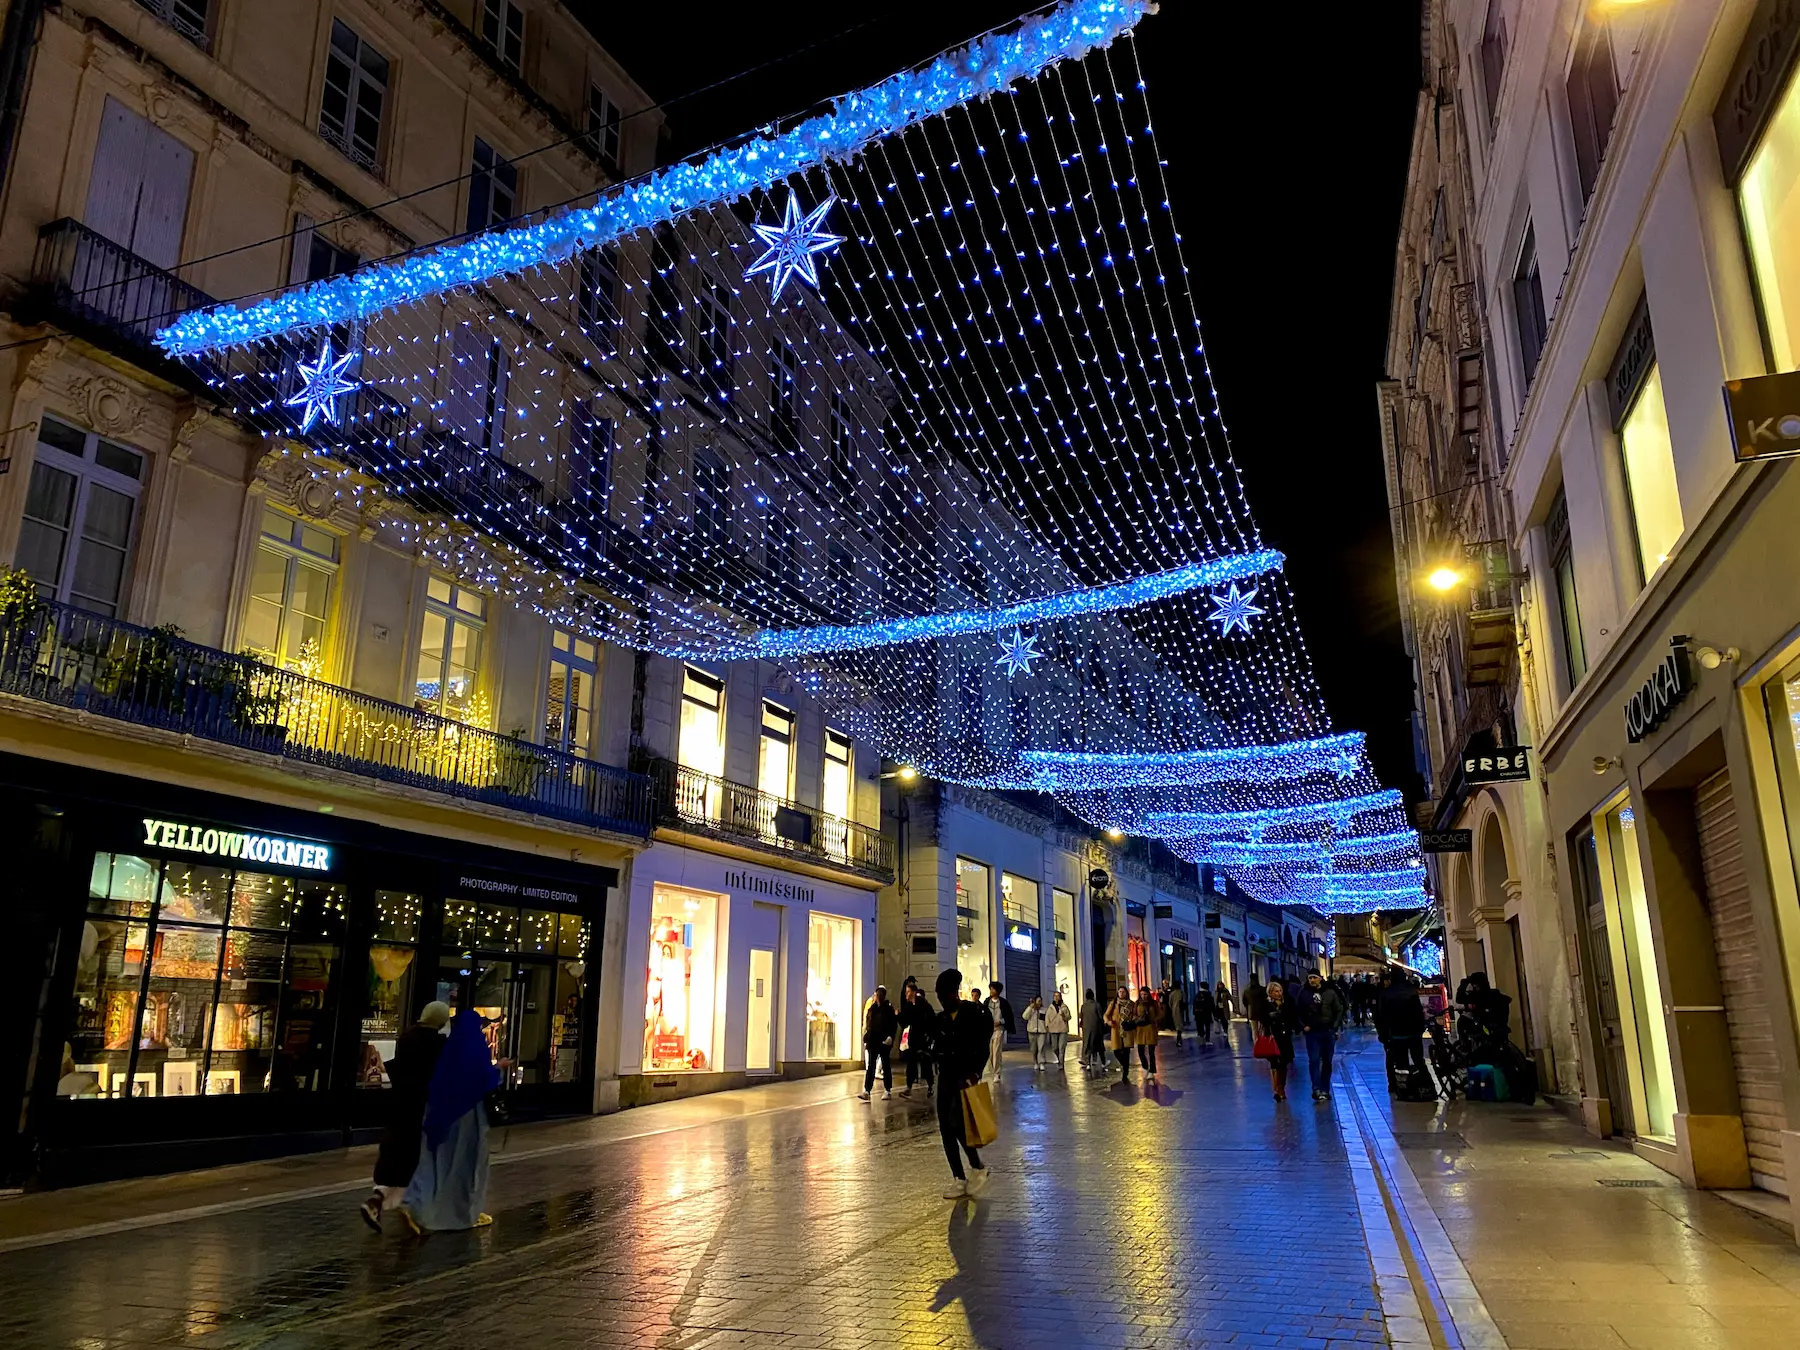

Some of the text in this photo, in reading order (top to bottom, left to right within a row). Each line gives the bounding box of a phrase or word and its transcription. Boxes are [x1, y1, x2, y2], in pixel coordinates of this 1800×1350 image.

[1465, 752, 1525, 772] ERBÉ
[143, 819, 329, 871] YELLOWKORNER
[1423, 833, 1469, 845] BOCAGE
[460, 877, 578, 903] PHOTOGRAPHY LIMITED EDITION
